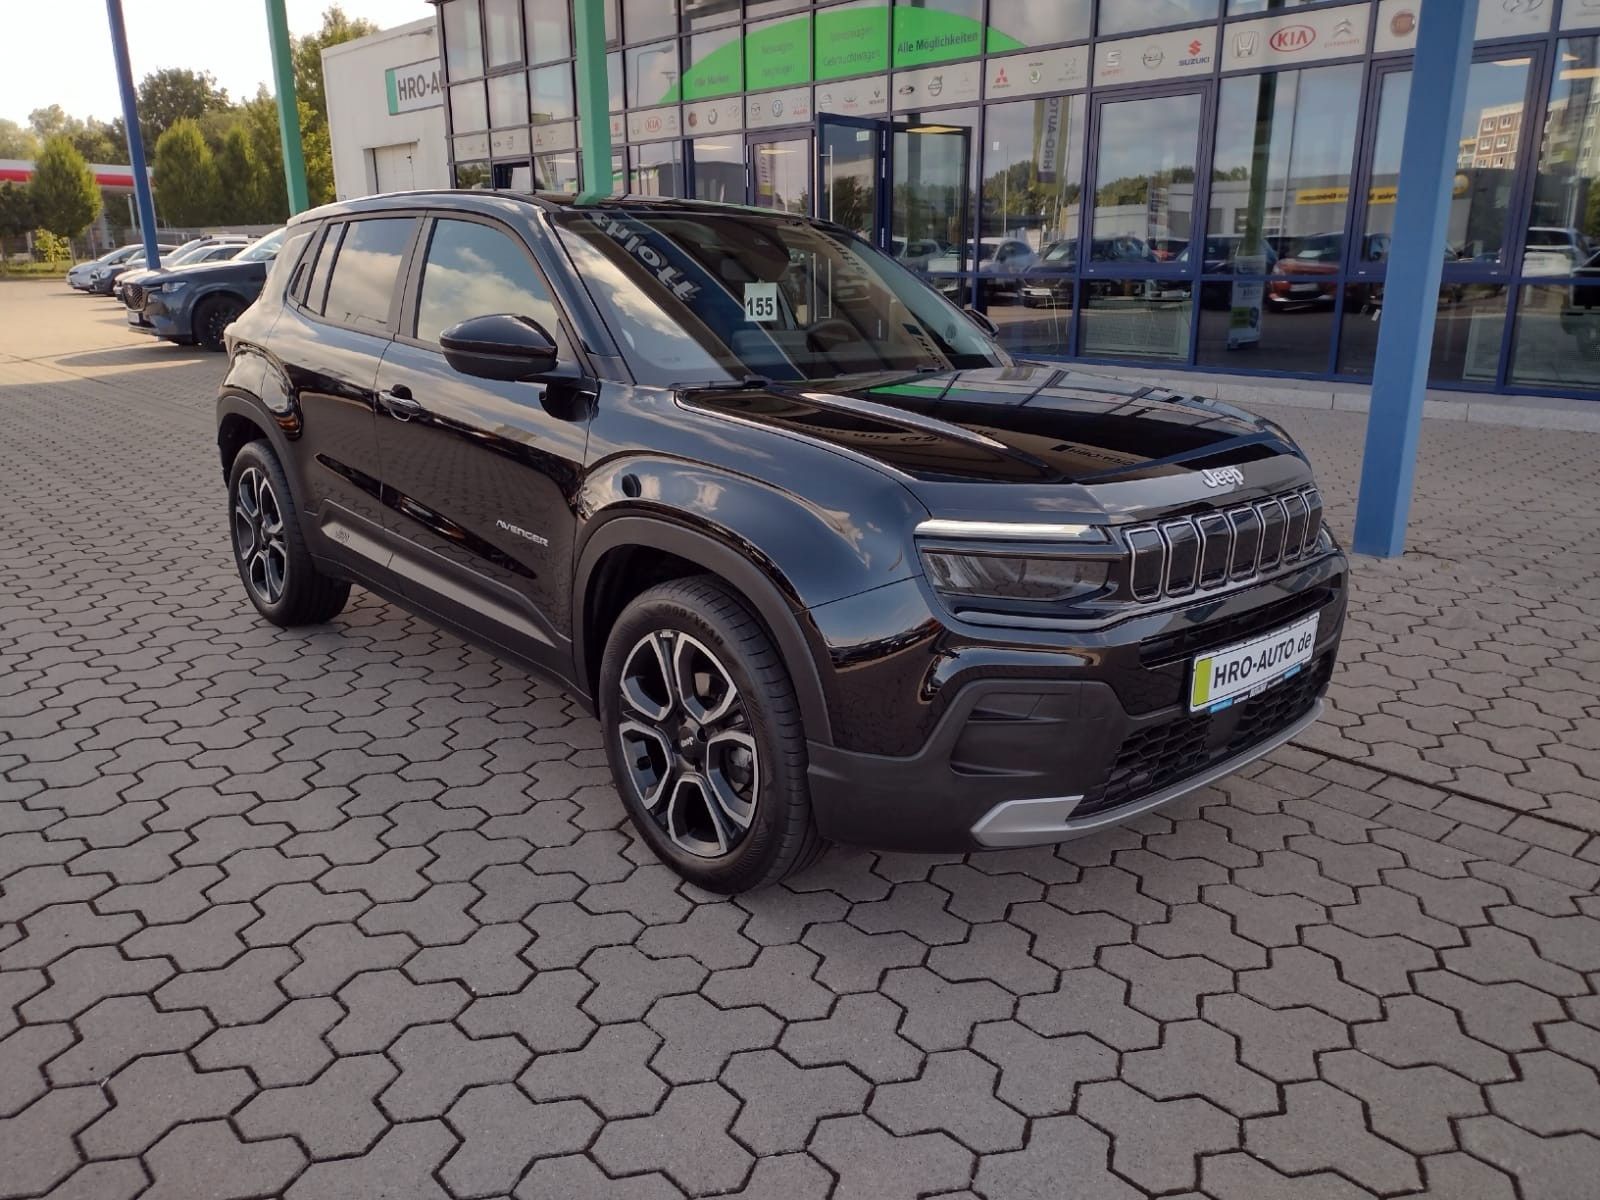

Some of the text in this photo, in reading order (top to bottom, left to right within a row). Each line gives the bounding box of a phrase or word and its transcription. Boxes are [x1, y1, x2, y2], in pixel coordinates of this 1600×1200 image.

[897, 39, 914, 54] Alle
[1278, 30, 1308, 47] KIA
[1178, 56, 1210, 66] SUZUKI
[398, 71, 443, 101] HRO-A
[747, 296, 774, 316] 155
[1201, 469, 1244, 488] Jeep
[496, 519, 549, 547] AVENGER
[1213, 638, 1295, 688] HRO-AUTO
